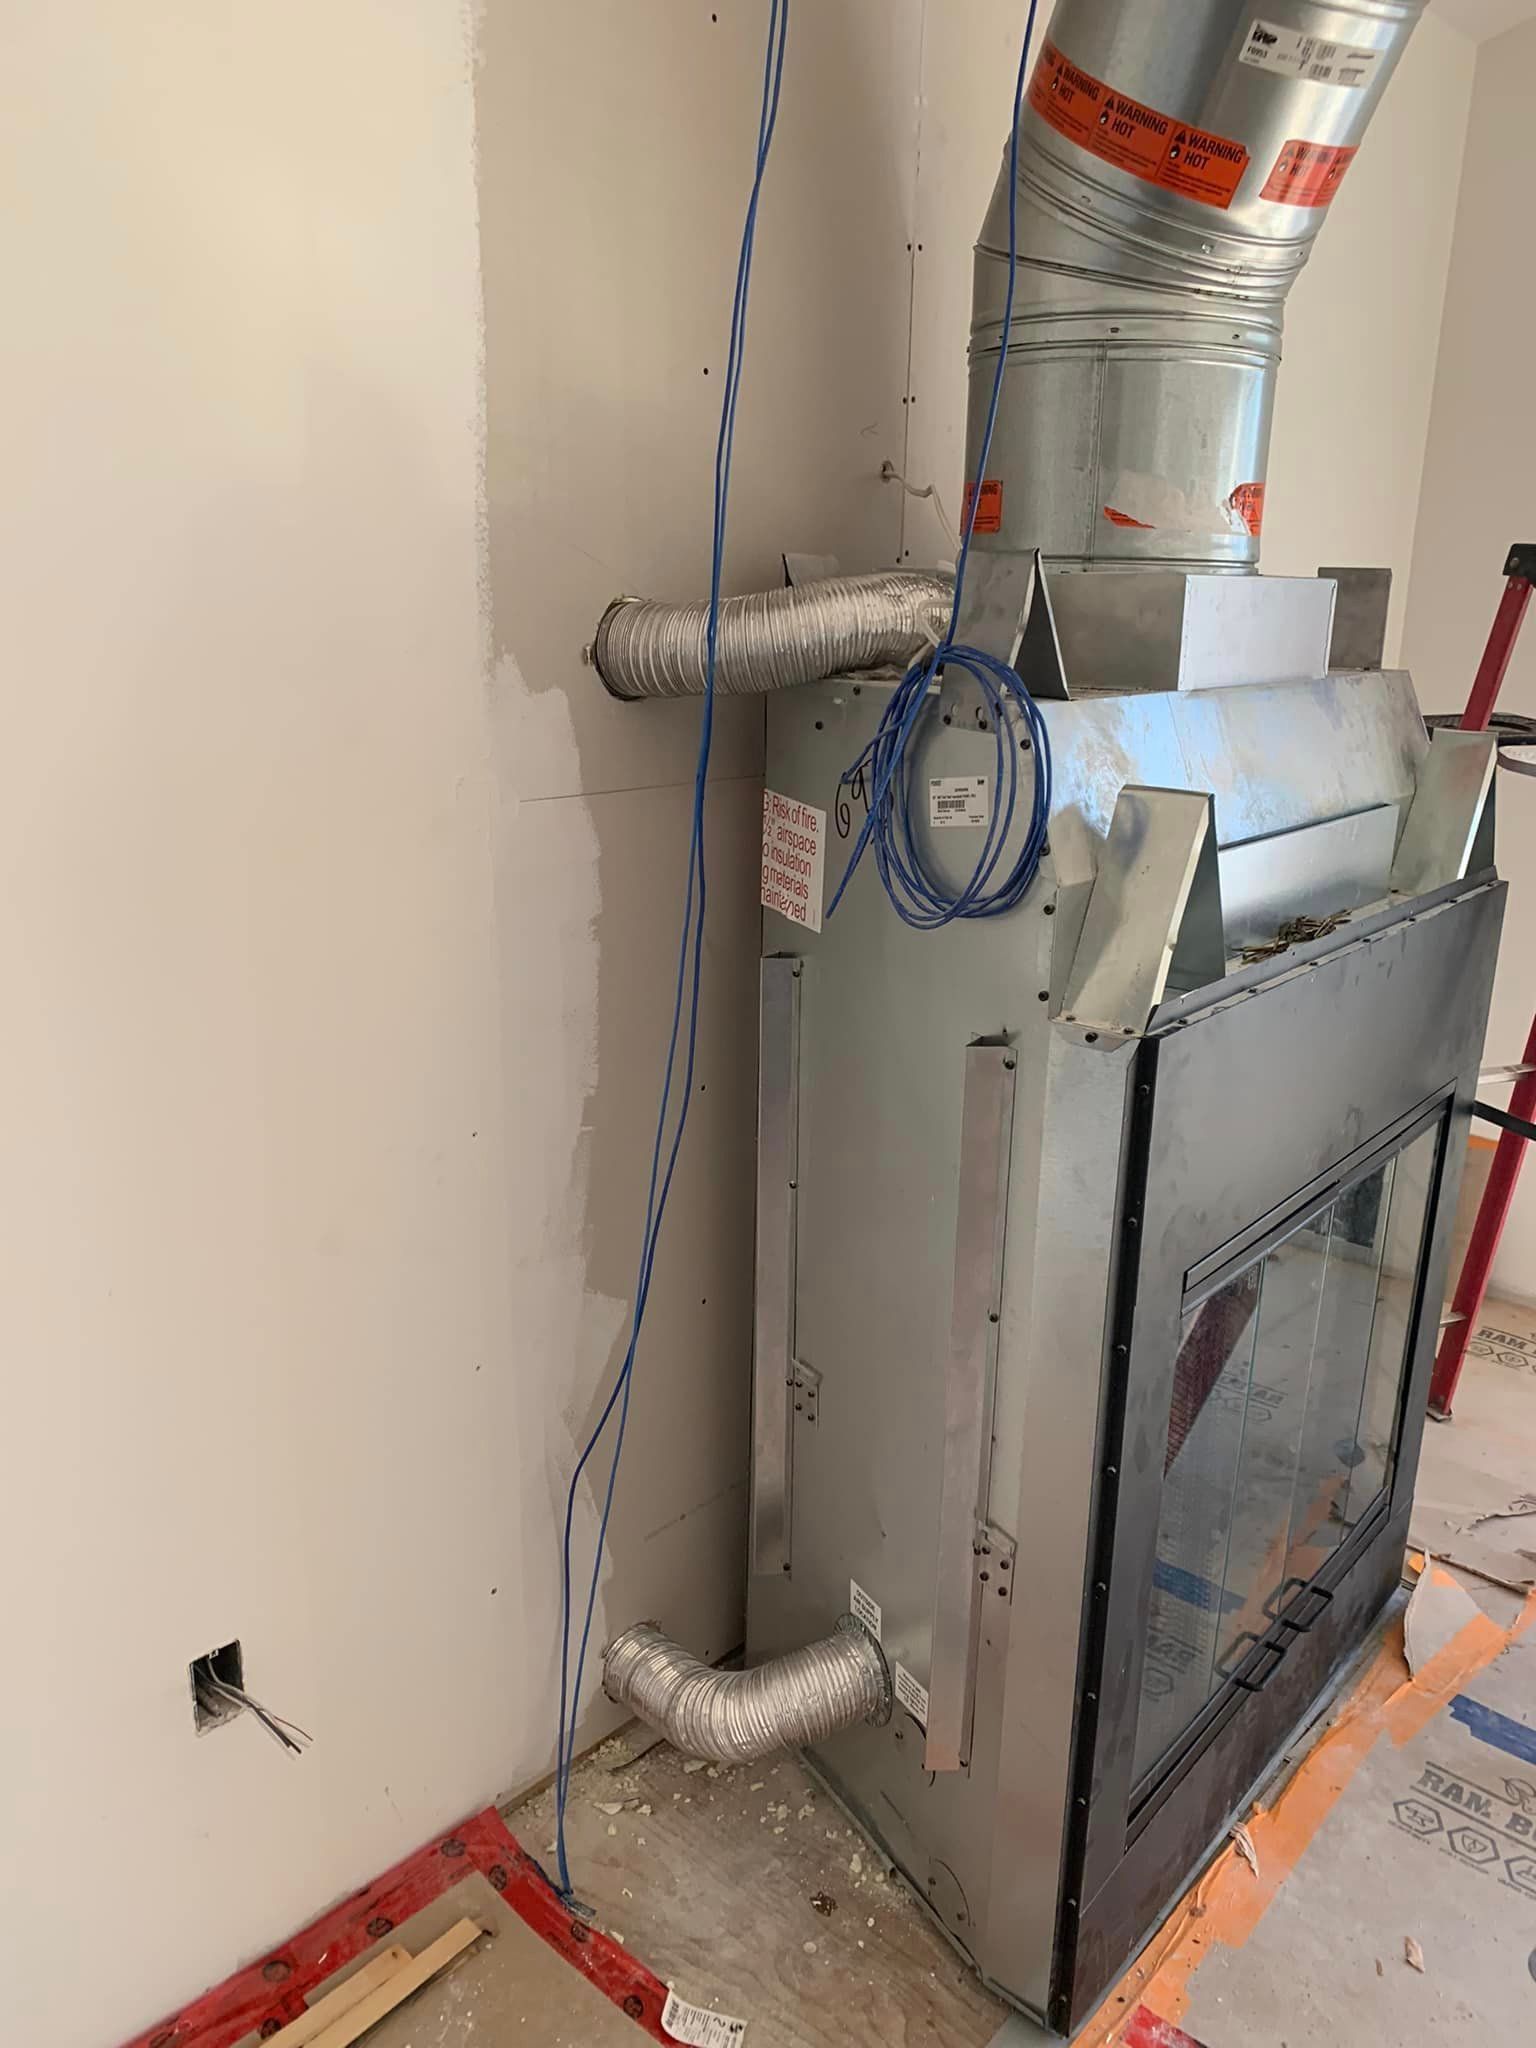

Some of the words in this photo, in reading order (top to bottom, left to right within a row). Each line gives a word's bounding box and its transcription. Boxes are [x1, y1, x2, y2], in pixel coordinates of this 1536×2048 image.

[1058, 85, 1076, 103] HOT
[1062, 65, 1100, 101] WARNING
[1112, 117, 1136, 139] HOT
[1115, 99, 1169, 136] WARNING
[1183, 151, 1211, 170] HOT
[1187, 133, 1245, 164] WARNING
[772, 795, 790, 822] Risk
[791, 805, 802, 825] of
[777, 824, 817, 856] airspace
[770, 842, 811, 878] insulation
[770, 867, 809, 900] materials
[1477, 1329, 1528, 1350] RAM
[1416, 1768, 1493, 1818] RAM
